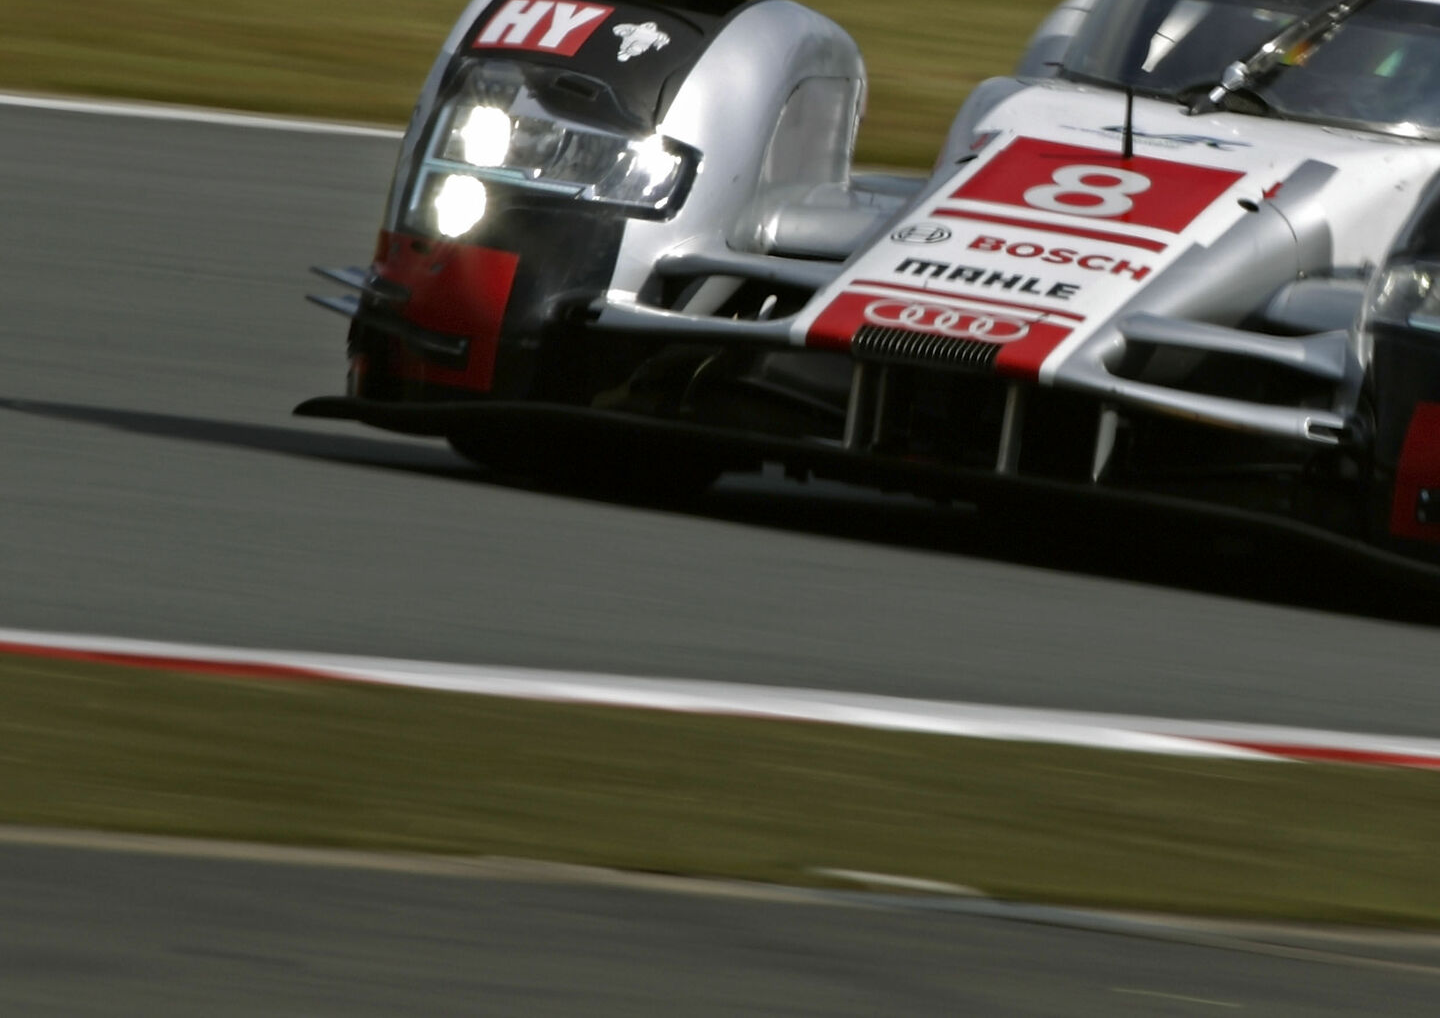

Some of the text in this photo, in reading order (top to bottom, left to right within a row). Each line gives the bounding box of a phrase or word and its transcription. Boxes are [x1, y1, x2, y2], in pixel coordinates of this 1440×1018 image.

[1023, 163, 1152, 218] 8
[894, 256, 1082, 301] MAHLE
[967, 234, 1153, 282] BOSCH
